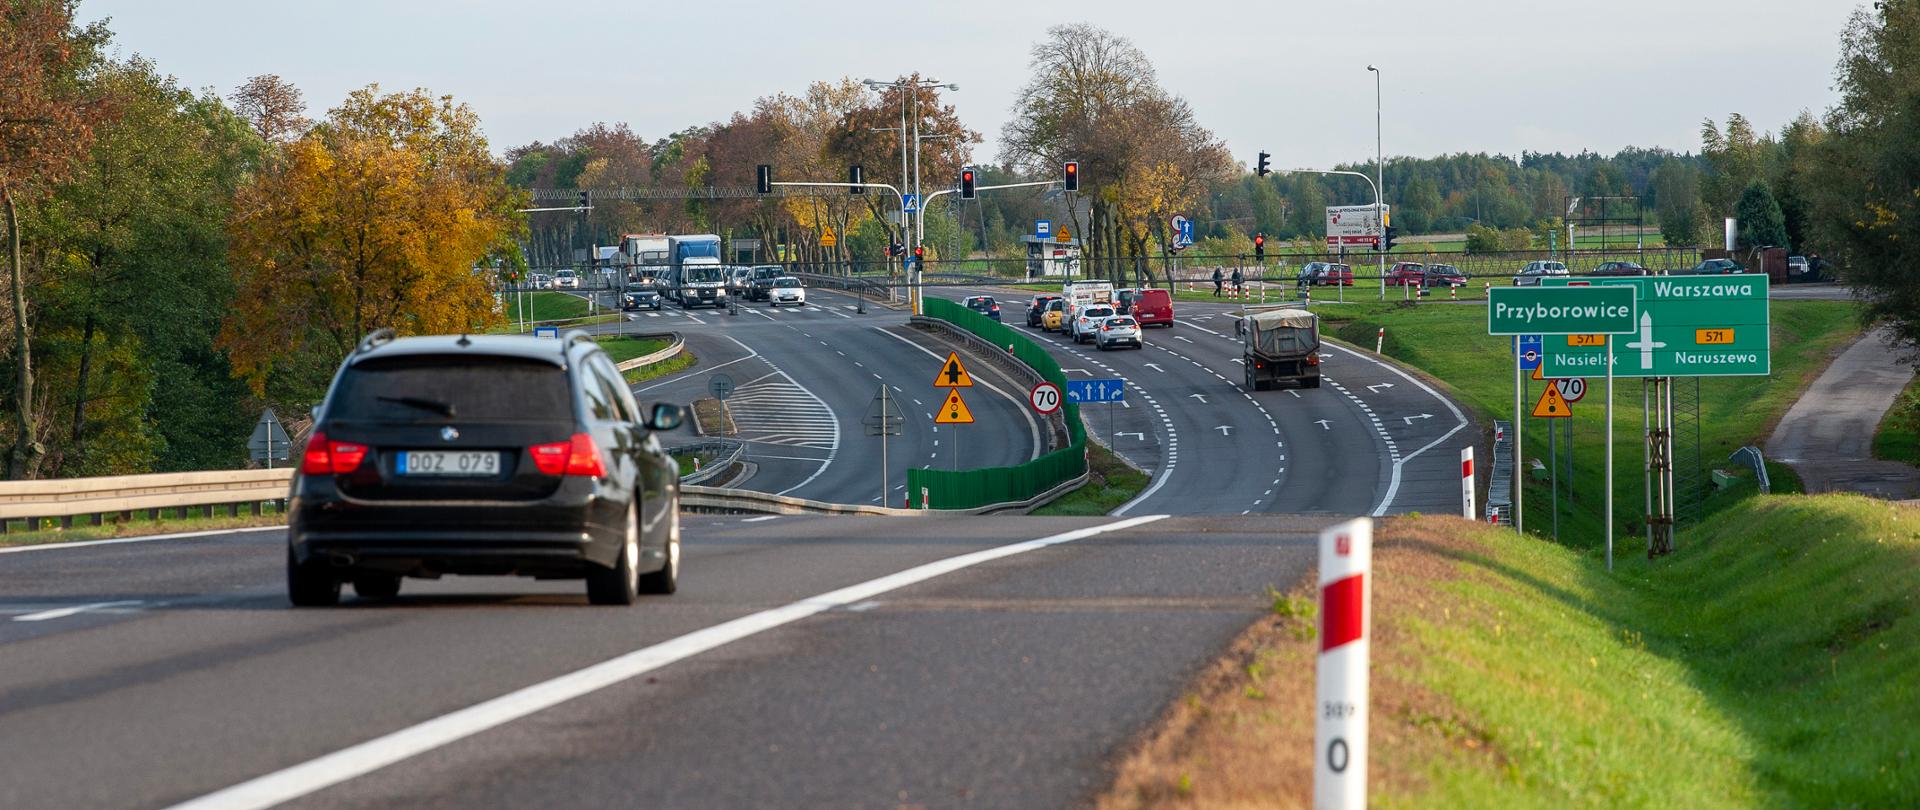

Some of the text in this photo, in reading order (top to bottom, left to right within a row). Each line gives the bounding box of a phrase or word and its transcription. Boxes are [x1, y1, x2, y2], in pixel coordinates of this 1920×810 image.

[1654, 281, 1752, 297] Warszawa
[1496, 302, 1629, 323] Przyborowice
[1577, 335, 1595, 344] 571
[1705, 331, 1723, 342] 571
[1675, 352, 1757, 364] Naruszewo
[1560, 379, 1582, 395] 70
[1036, 390, 1057, 406] 70
[458, 453, 495, 470] 079
[1327, 737, 1349, 774] 0
